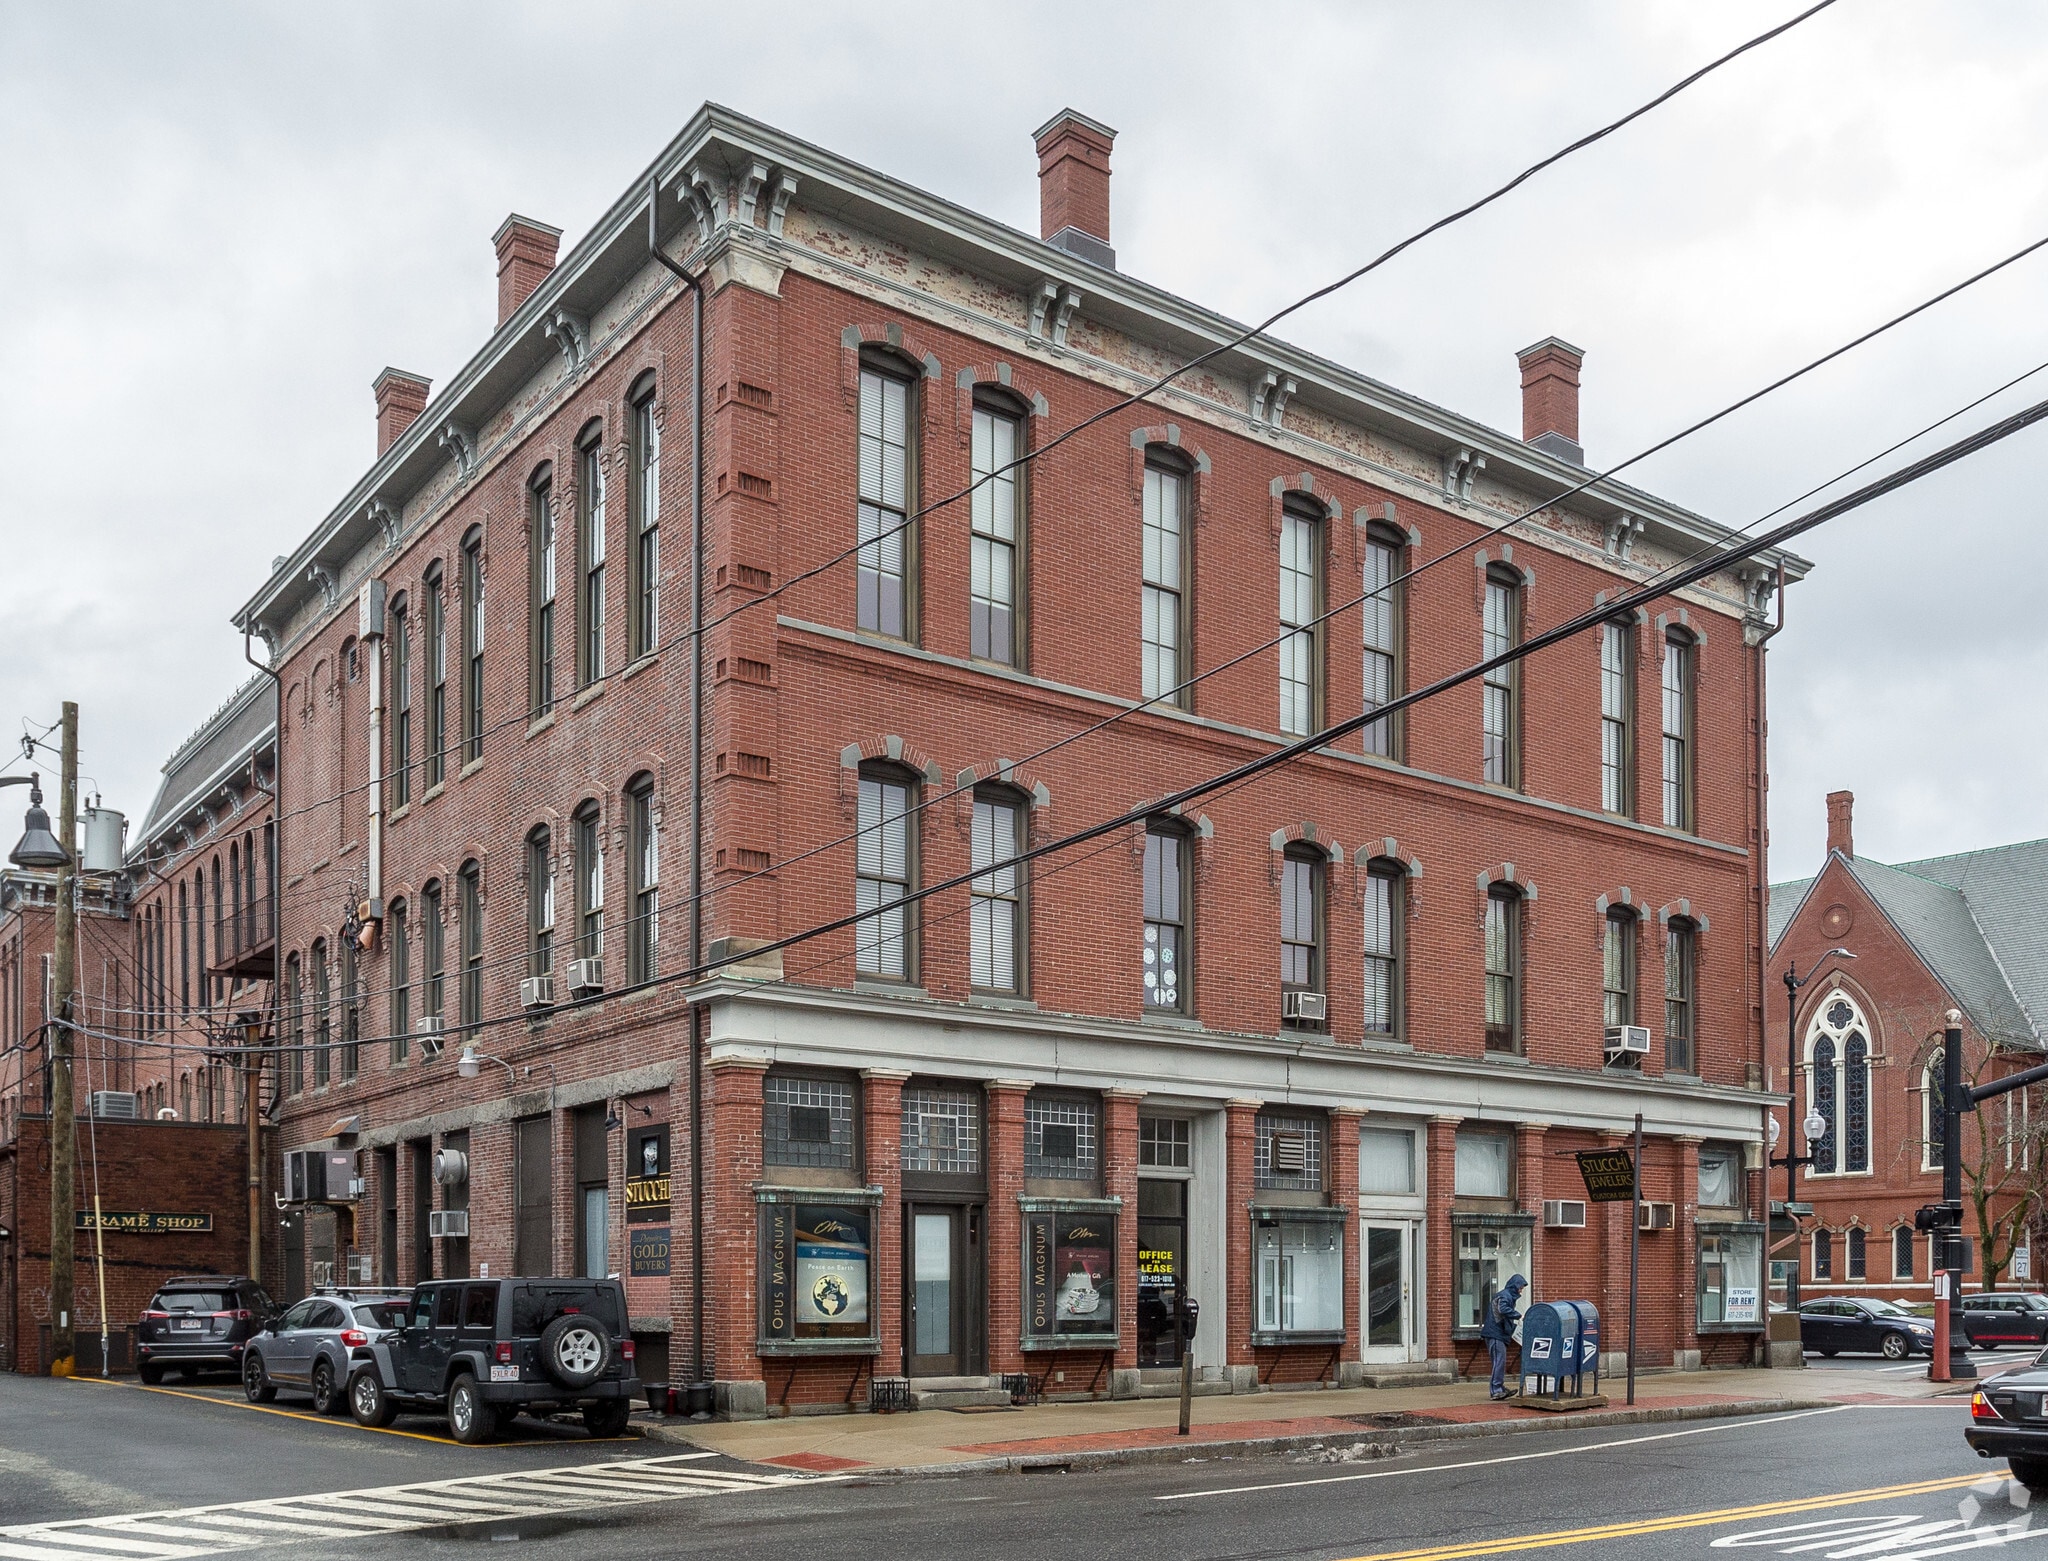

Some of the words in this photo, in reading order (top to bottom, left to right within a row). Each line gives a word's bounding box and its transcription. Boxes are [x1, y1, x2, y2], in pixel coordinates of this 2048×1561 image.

[1581, 1157, 1629, 1173] STUCCHI
[1589, 1174, 1634, 1190] JEWELERS
[83, 1215, 149, 1227] FRAME
[156, 1217, 204, 1228] SHOP
[633, 1243, 668, 1259] GOLD
[773, 1216, 785, 1285] MAGNUM
[1035, 1224, 1046, 1286] MAGNUM
[1139, 1250, 1173, 1259] OFFICE
[635, 1260, 666, 1271] BUYERS
[1141, 1264, 1173, 1273] LEASE
[2017, 1262, 2027, 1273] 27
[1728, 1297, 1738, 1305] FOR
[1740, 1297, 1755, 1305] RENT
[772, 1291, 785, 1329] OPUS
[1035, 1293, 1046, 1327] OPUS
